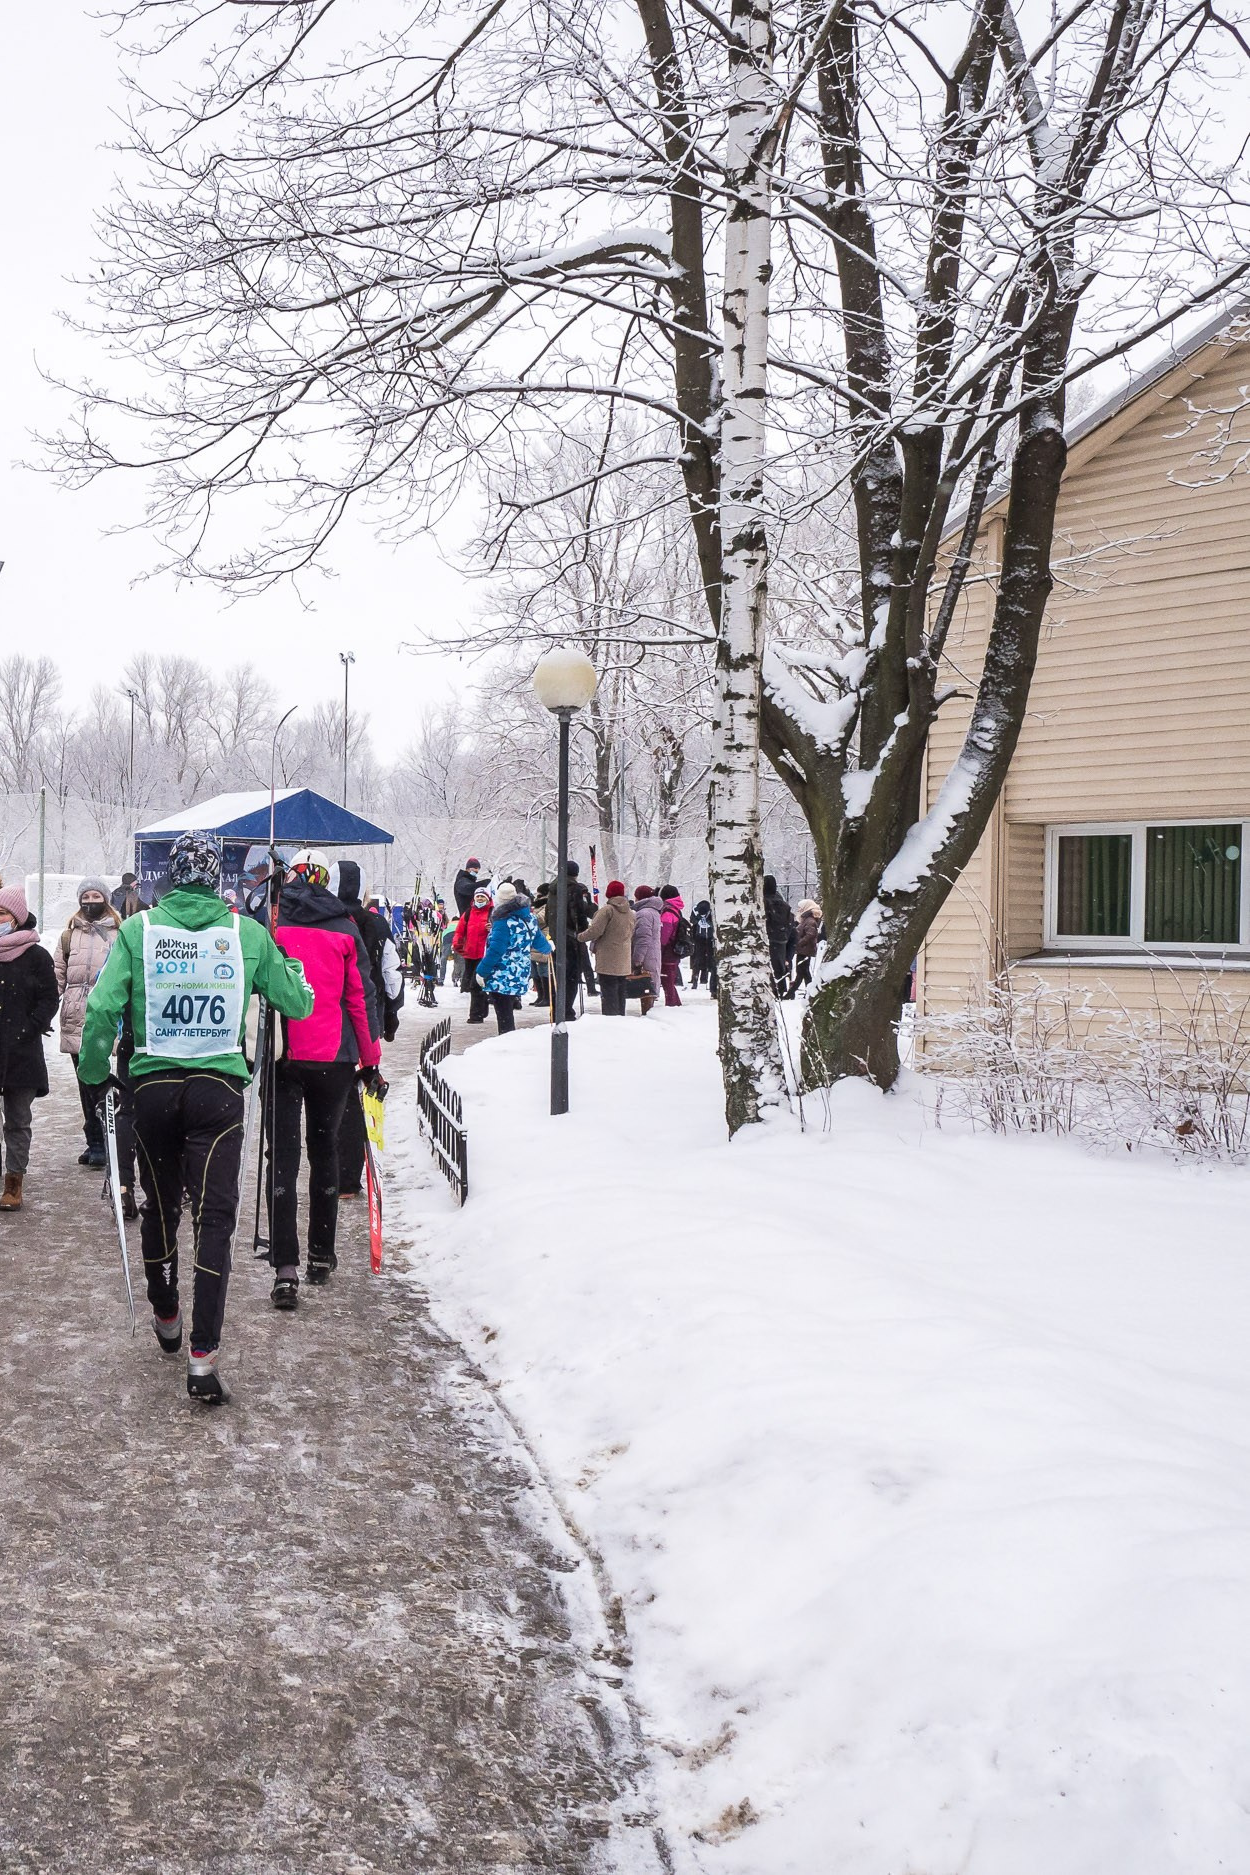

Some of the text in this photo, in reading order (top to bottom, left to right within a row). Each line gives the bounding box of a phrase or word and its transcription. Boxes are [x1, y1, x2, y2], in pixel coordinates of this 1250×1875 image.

[155, 938, 198, 950] ЛЫЖНЯ
[155, 949, 198, 960] РОССИИ
[156, 961, 195, 974] 2021
[155, 982, 236, 990] СПОРТ НОРМА ЖИЗНИ
[161, 994, 226, 1025] 4076
[155, 1027, 231, 1038] САНКТ-ПЕТЕРБУРГ
